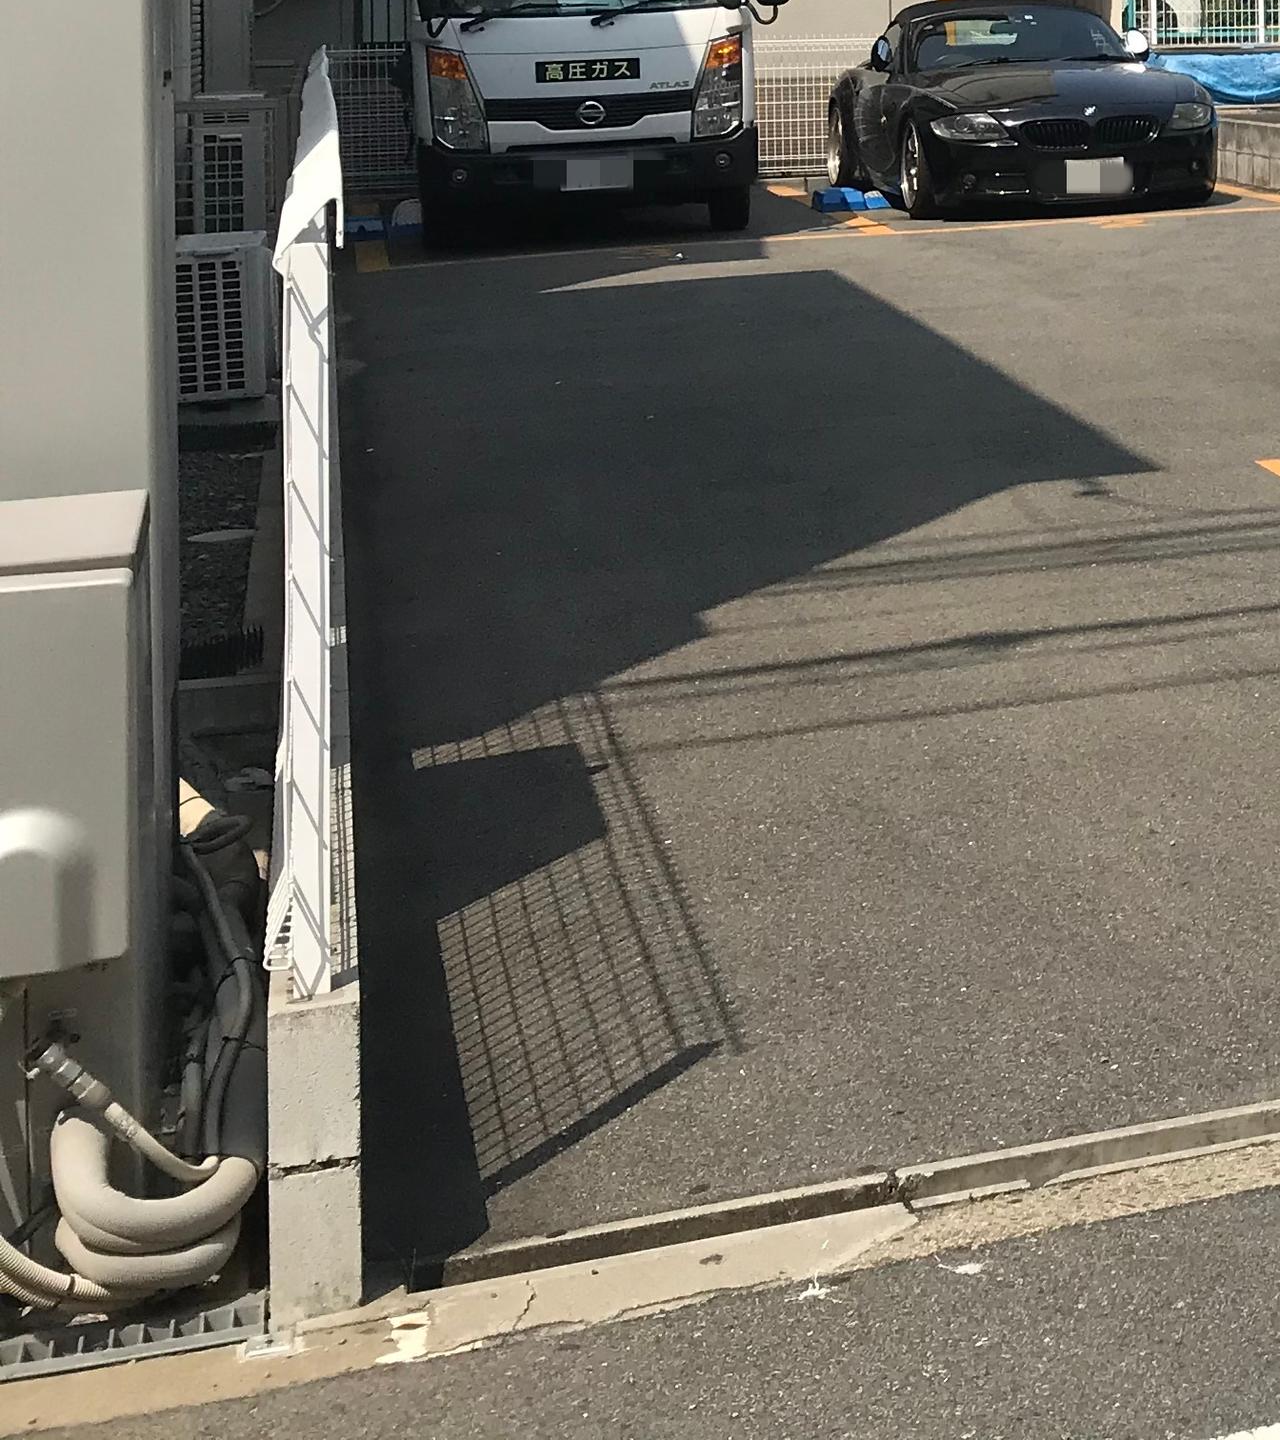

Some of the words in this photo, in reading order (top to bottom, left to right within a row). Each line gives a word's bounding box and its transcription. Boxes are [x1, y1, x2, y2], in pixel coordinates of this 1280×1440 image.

[545, 61, 631, 81] 高圧ガス
[649, 81, 690, 90] ATLAS
